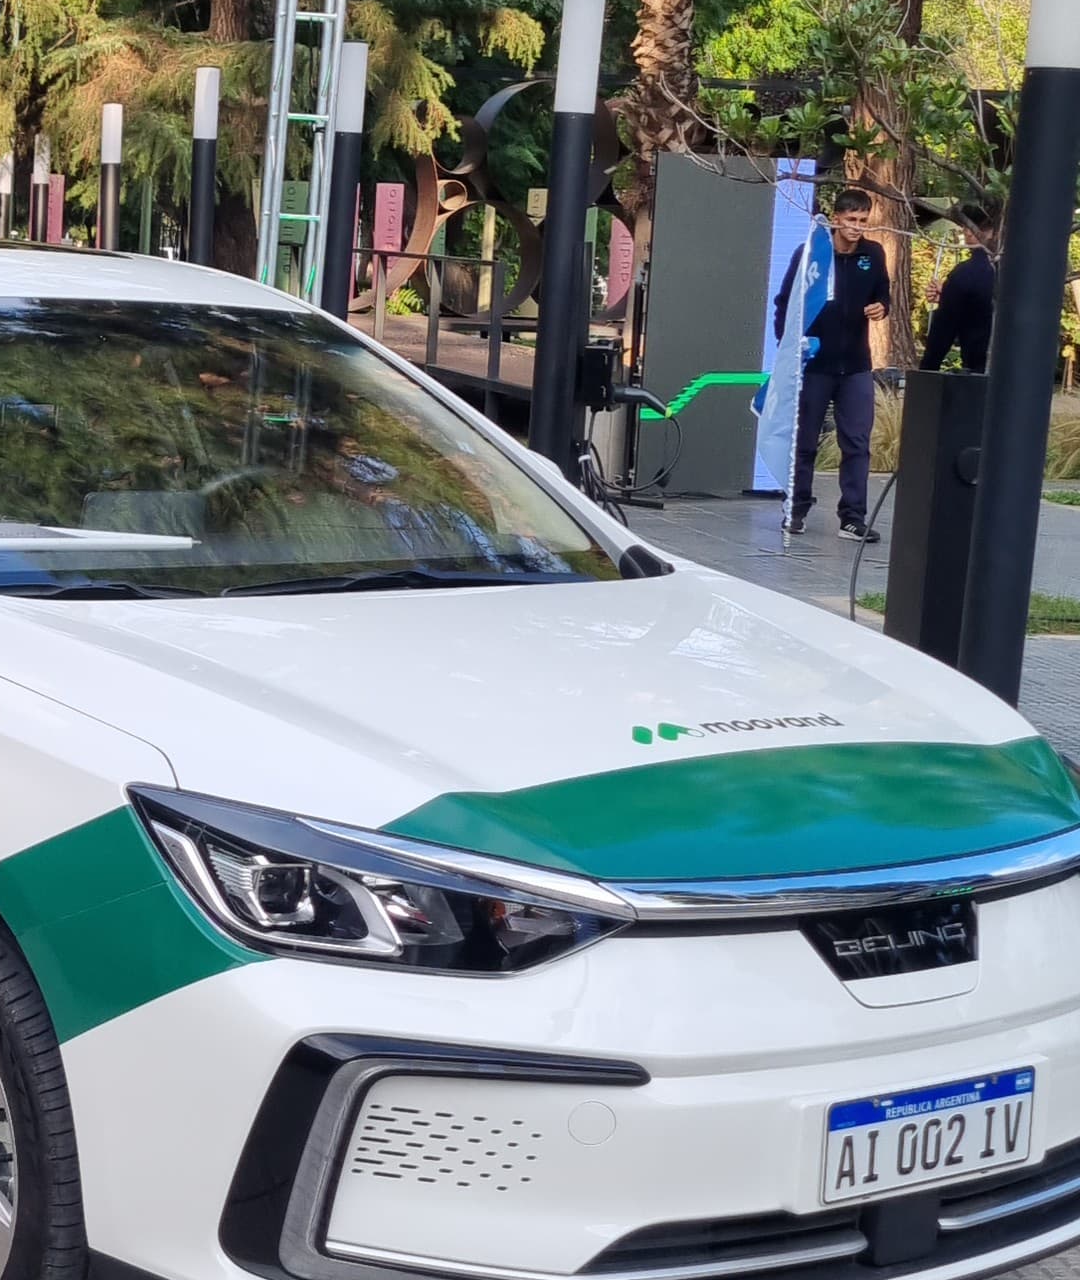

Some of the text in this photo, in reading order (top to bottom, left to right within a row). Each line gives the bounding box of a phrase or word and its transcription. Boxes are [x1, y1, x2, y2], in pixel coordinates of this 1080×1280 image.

[701, 713, 844, 735] moovand
[834, 922, 966, 956] BEIJING
[885, 1091, 982, 1120] REPÚBLICA ARGENTINA
[836, 1101, 1023, 1190] AI 002 IV
